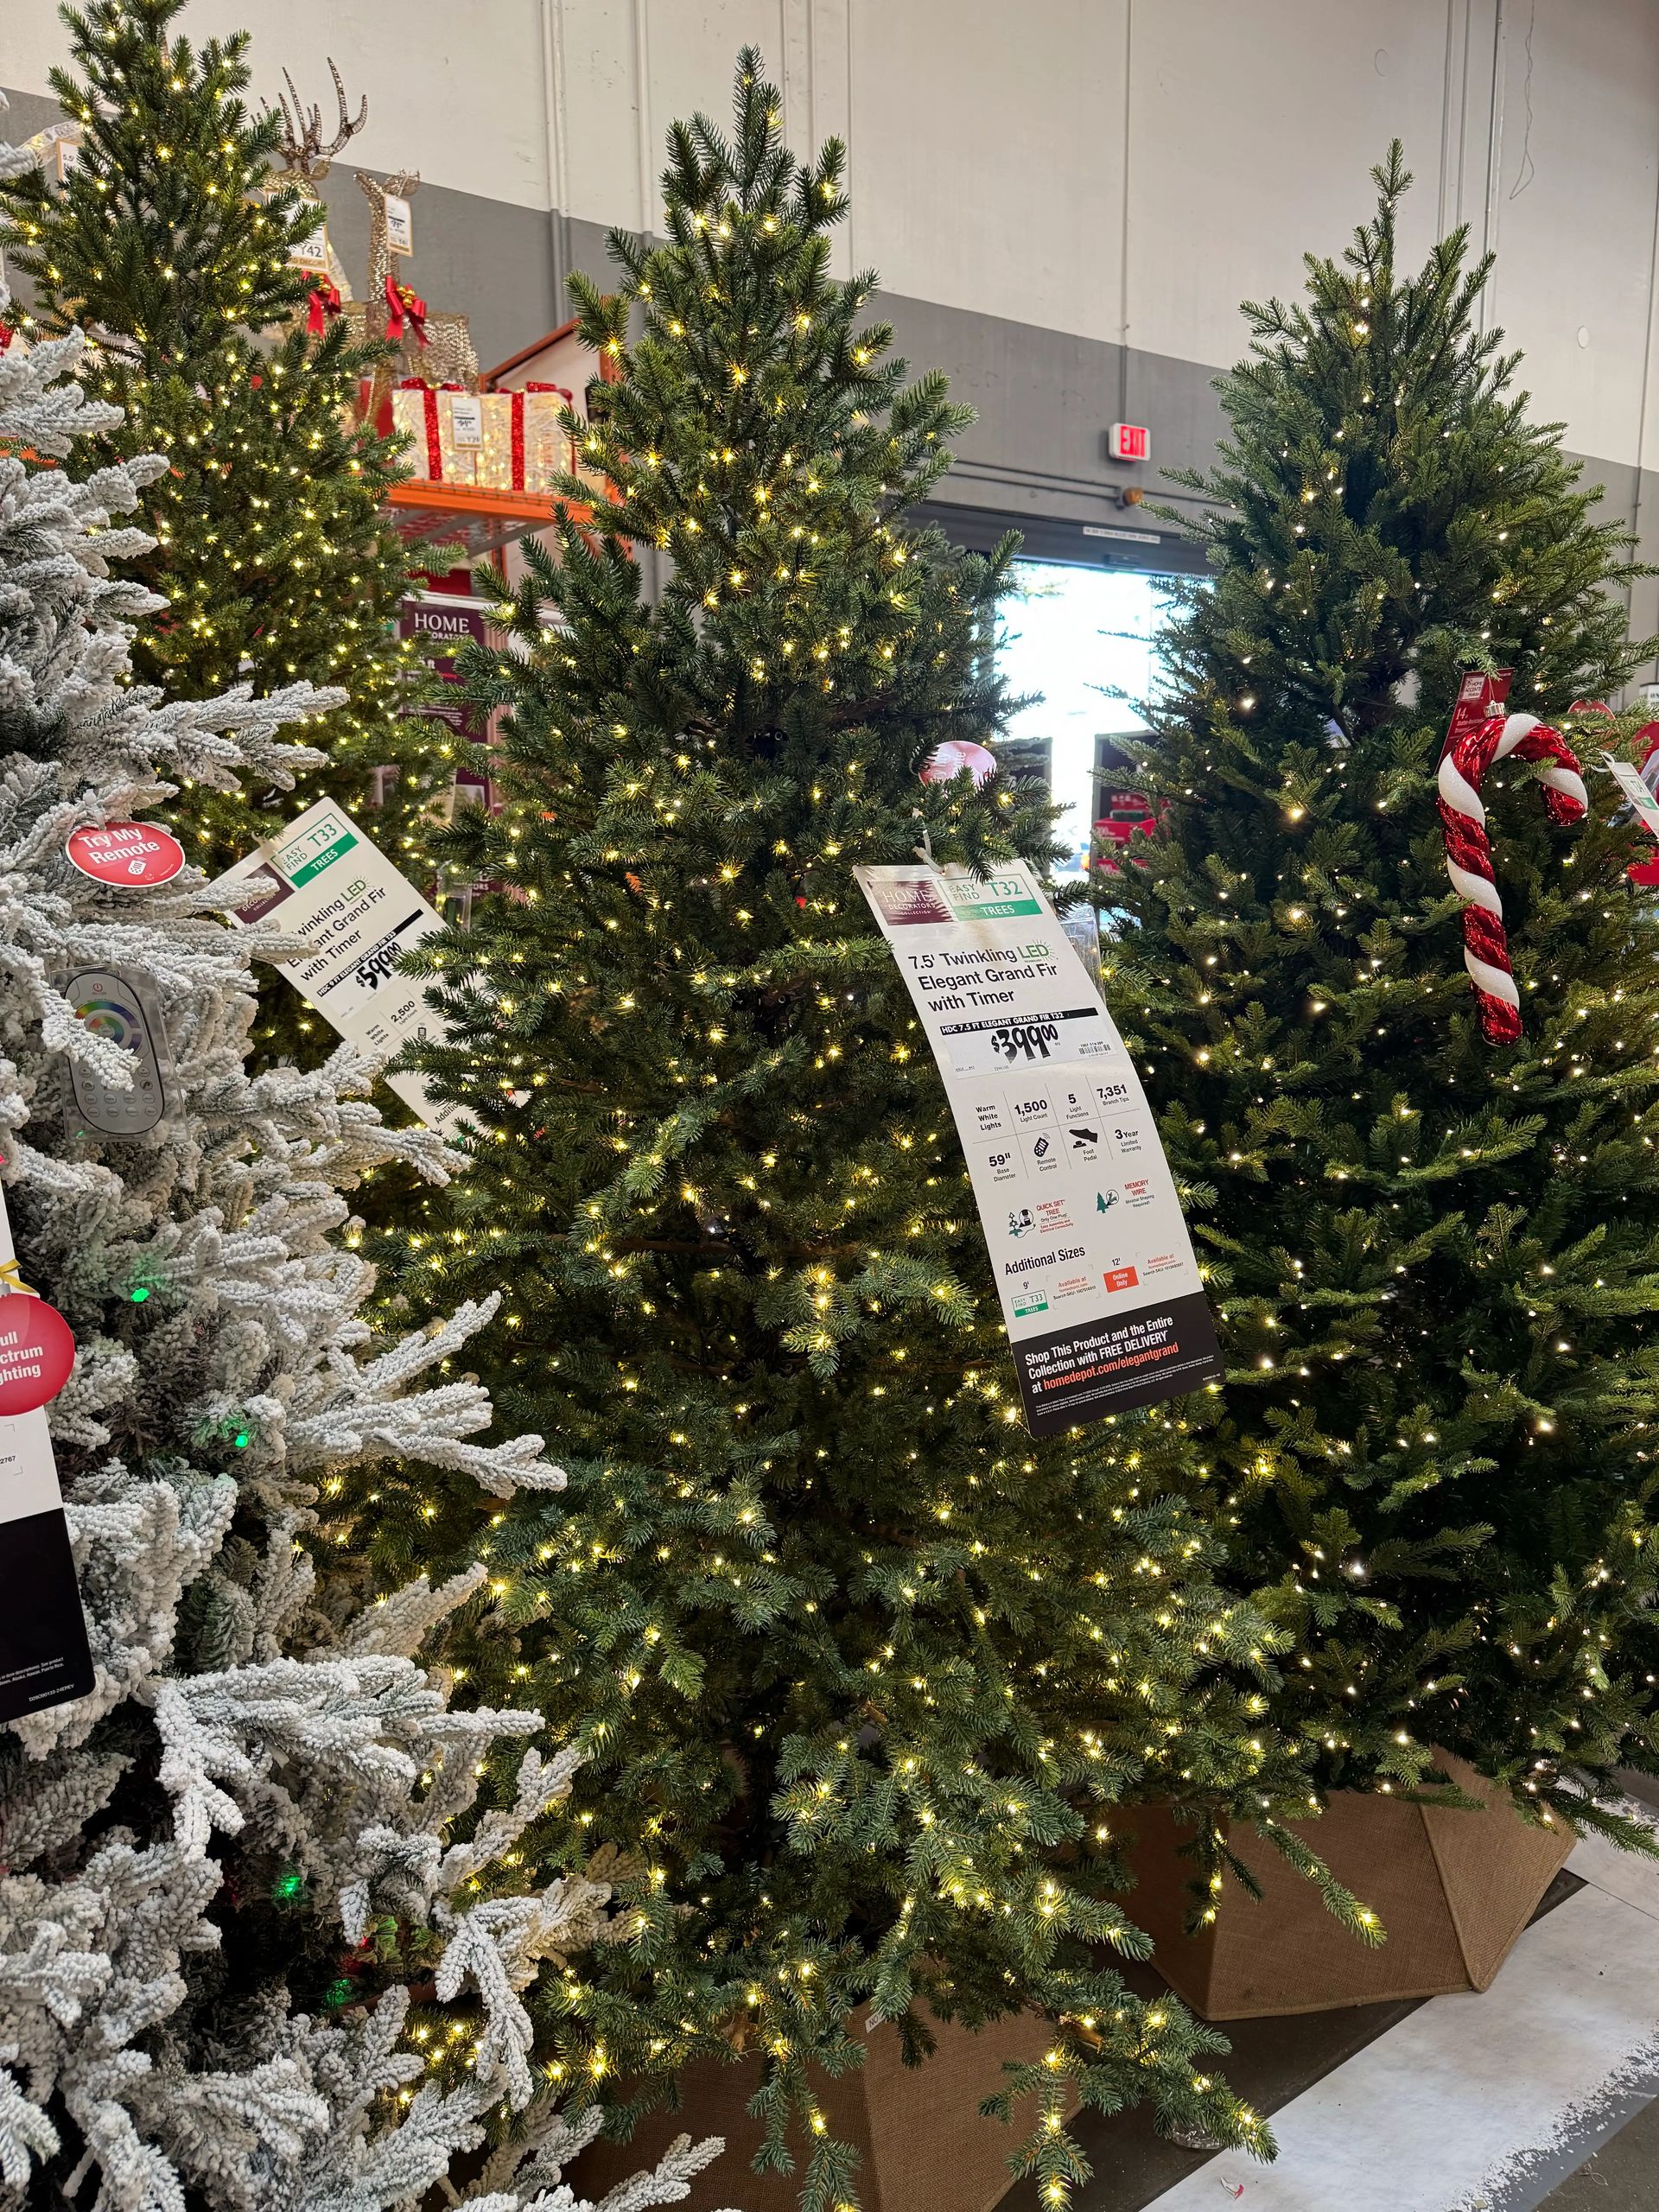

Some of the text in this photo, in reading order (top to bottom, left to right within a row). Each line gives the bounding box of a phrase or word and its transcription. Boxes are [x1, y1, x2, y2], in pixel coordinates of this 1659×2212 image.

[301, 245, 322, 257] Y42
[1120, 425, 1146, 457] EXIT
[415, 613, 470, 633] HOME
[1455, 707, 1466, 720] 14
[78, 828, 143, 849] Try My
[307, 823, 338, 848] T33
[88, 841, 160, 864] Remote
[286, 852, 308, 870] FIND
[310, 849, 339, 872] TREES
[883, 880, 1024, 904] HOME EASY T32
[954, 892, 981, 901] FIND
[296, 899, 346, 938] winkling
[341, 879, 366, 902] LED
[333, 899, 371, 931] Grand
[368, 886, 386, 905] Fir
[981, 905, 1015, 916] TREES
[301, 930, 363, 982] with Timer
[908, 944, 1051, 969] 7.5' Twinkling LED
[318, 984, 330, 996] HDC
[339, 959, 363, 982] ELEGANT
[360, 945, 380, 963] GRAND
[918, 963, 1058, 991] Elegant Grand Fir
[927, 990, 1014, 1012] with Timer
[391, 1000, 416, 1023] 2,500
[365, 1024, 380, 1036] Warm
[941, 1025, 958, 1034] HDC
[958, 1022, 971, 1032] 7.5
[982, 1018, 1013, 1028] ELEGANT
[1014, 1014, 1038, 1024] GRAND
[1039, 1013, 1051, 1021] FIR
[370, 1028, 385, 1040] White
[374, 1033, 389, 1046] Lights
[1067, 1093, 1077, 1104] 5
[1096, 1084, 1128, 1100] 7,351
[1014, 1099, 1048, 1116] 1,500
[1103, 1097, 1116, 1106] Branch
[435, 1103, 459, 1124] Additio
[976, 1104, 995, 1113] Warm
[978, 1112, 998, 1122] White
[1020, 1114, 1033, 1123] Light
[1066, 1111, 1089, 1121] Functions
[980, 1122, 1001, 1131] Lights
[1114, 1128, 1139, 1140] 3 Year
[1120, 1139, 1138, 1147] Limited
[1121, 1145, 1141, 1154] Warranty
[988, 1152, 1011, 1167] 59"
[1037, 1157, 1056, 1166] Remote
[994, 1173, 1016, 1182] Diameter
[1124, 1179, 1149, 1191] MEMORY
[1131, 1188, 1147, 1197] WIRE
[1036, 1201, 1053, 1211] QUICK
[1005, 1246, 1085, 1275] Additional Sizes
[1111, 1257, 1122, 1267] 12'
[1147, 1255, 1168, 1265] Available
[1058, 1278, 1079, 1287] Available
[1112, 1272, 1128, 1281] Online
[1116, 1279, 1128, 1287] Only
[1030, 1294, 1043, 1303] T33
[1024, 1306, 1039, 1314] TREES
[0, 1331, 17, 1345] ull
[1025, 1315, 1173, 1366] Shop This Product and the Entire
[0, 1345, 43, 1364] ctrum
[1028, 1357, 1076, 1380] Collection
[1077, 1350, 1099, 1365] with
[1099, 1344, 1124, 1360] FREE
[1032, 1380, 1043, 1395] at
[1043, 1342, 1179, 1390] homedepot.com/elegantgrand
[0, 1364, 41, 1384] hting
